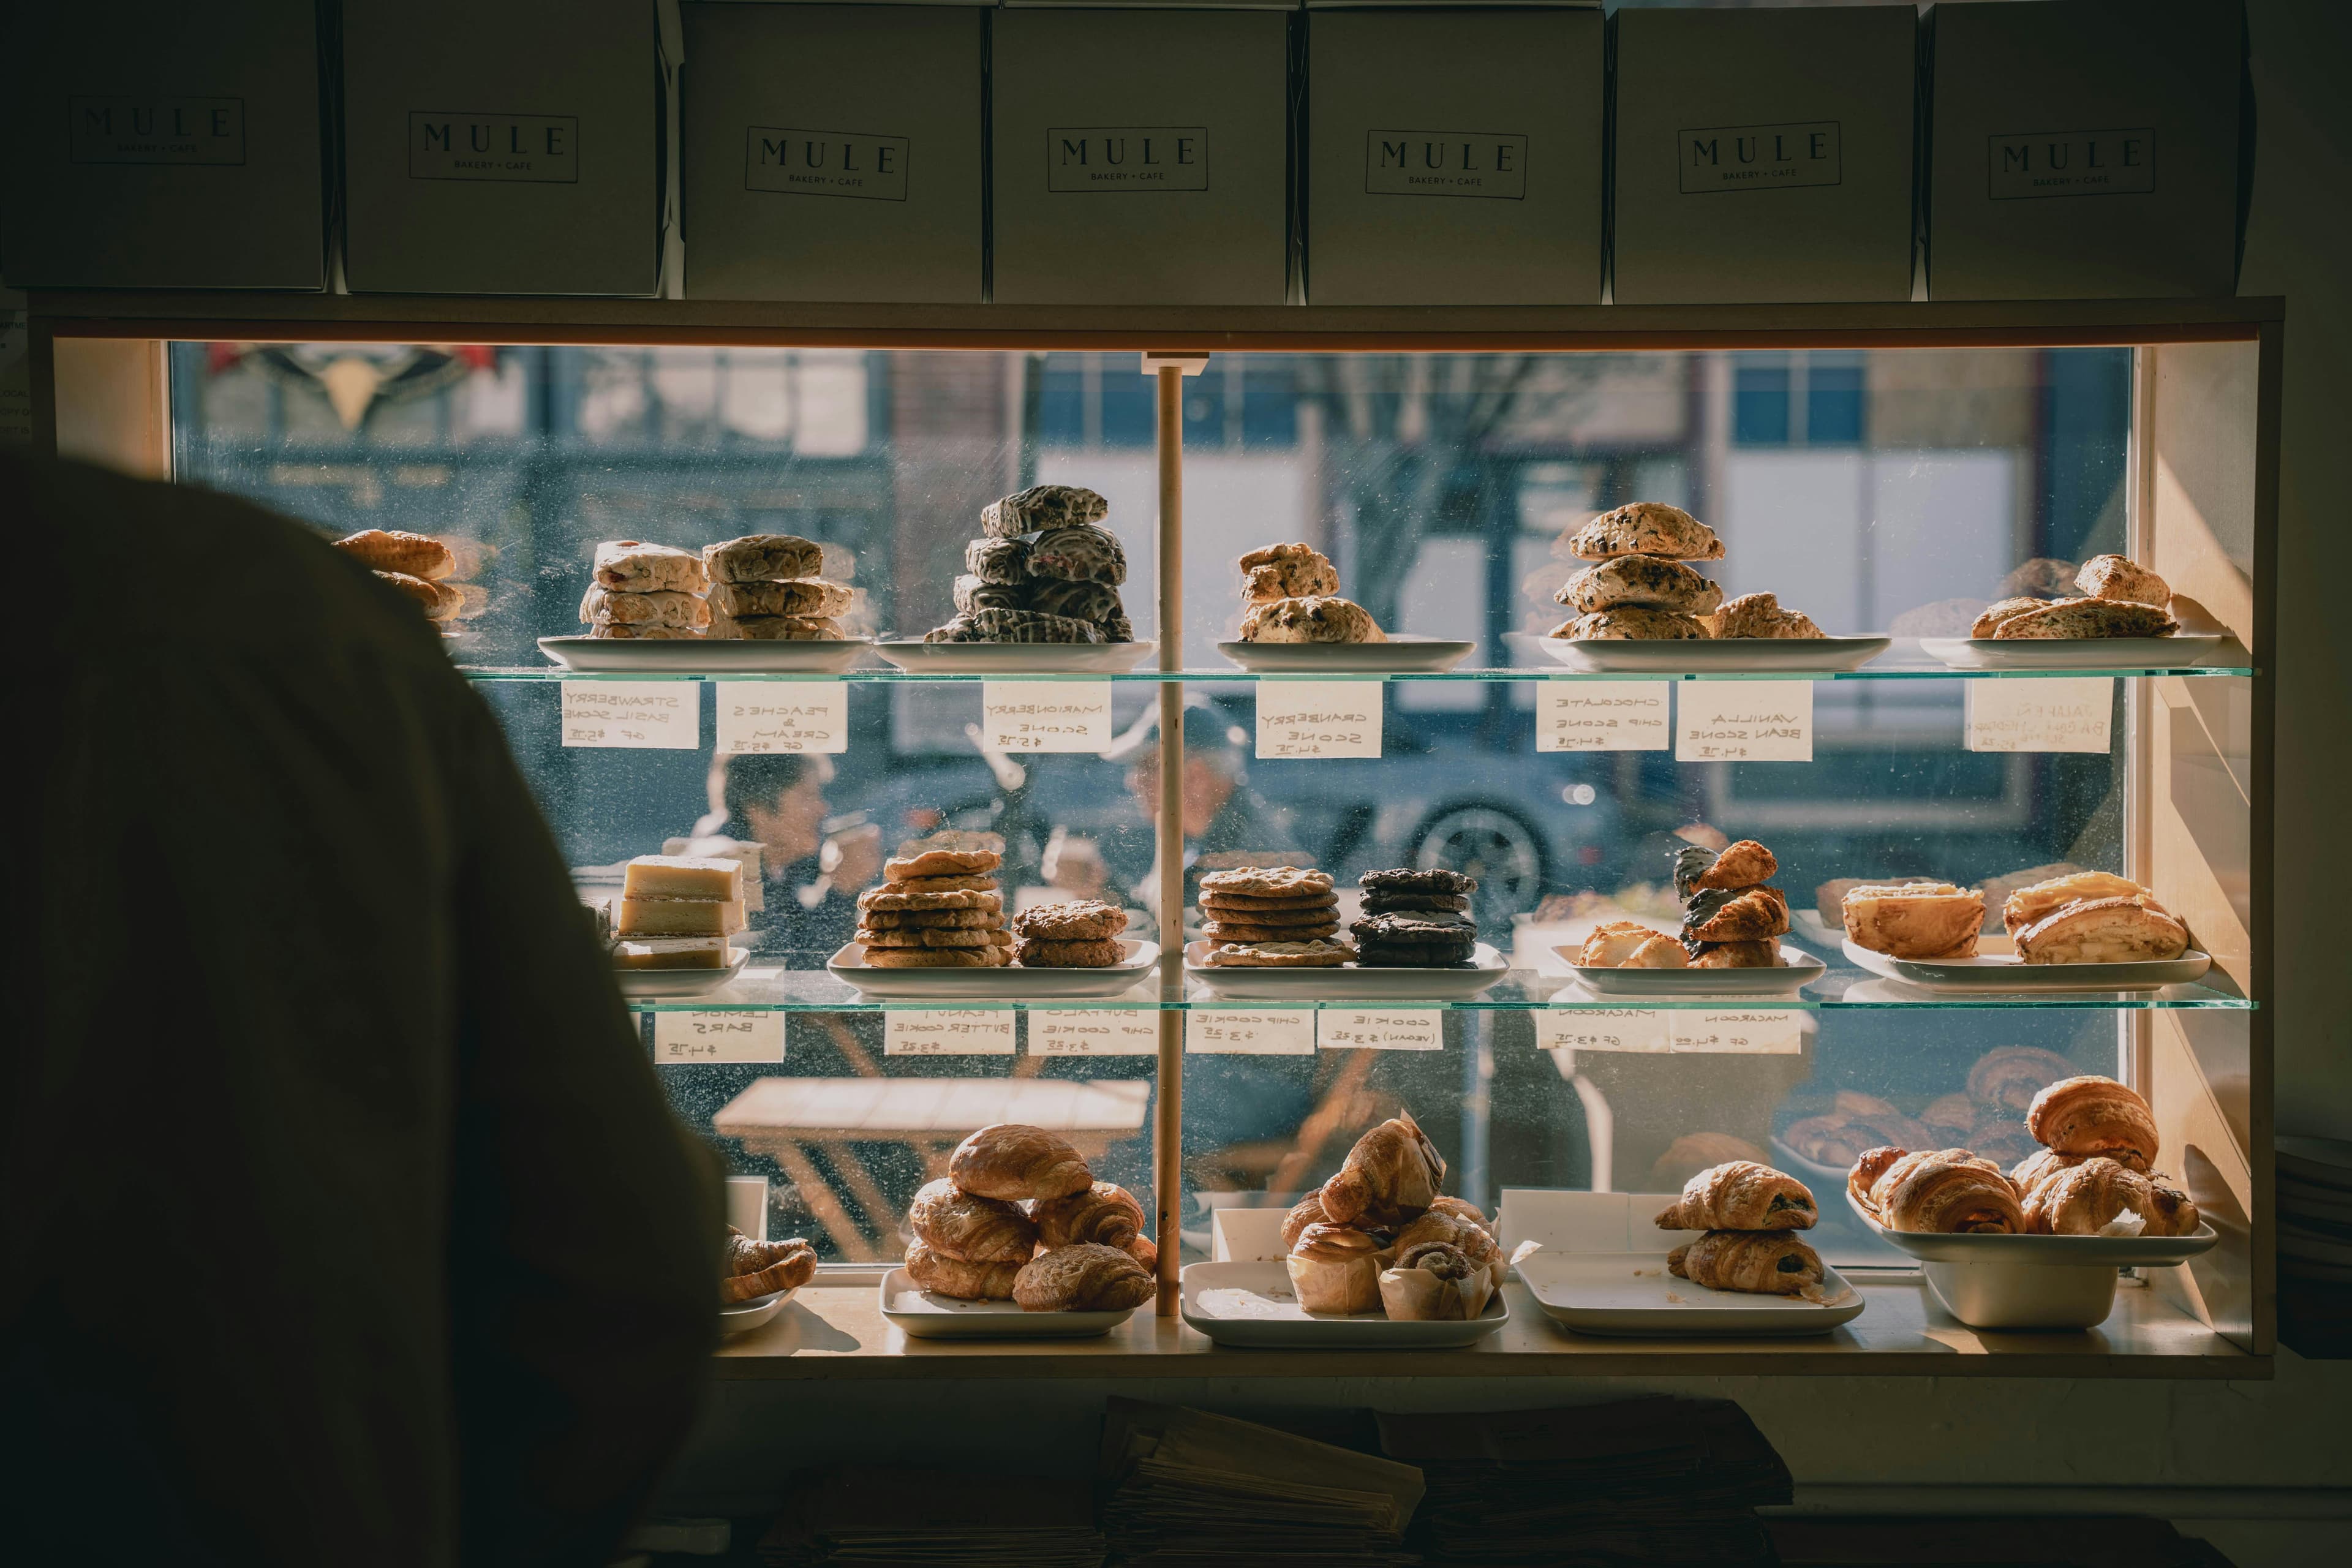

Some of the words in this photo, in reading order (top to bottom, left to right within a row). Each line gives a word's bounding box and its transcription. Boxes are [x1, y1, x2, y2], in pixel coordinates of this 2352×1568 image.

[85, 107, 230, 137] MULE
[423, 123, 564, 155] MULE
[1061, 138, 1194, 166] MULE
[1692, 132, 1827, 167] MULE
[454, 160, 494, 170] BAKERY
[505, 160, 533, 171] CAFE
[760, 138, 895, 174] MULE
[1380, 141, 1514, 172] MULE
[2003, 138, 2141, 173] MULE
[788, 175, 827, 184] BAKERY
[837, 178, 863, 187] CAFE
[1139, 172, 1164, 181] CAFE
[1408, 176, 1446, 185] BAKERY
[1457, 178, 1482, 186] CAFE
[1722, 170, 1760, 181] BAKERY
[1771, 168, 1797, 177] CAFE
[2033, 177, 2071, 187] BAKERY
[2083, 176, 2109, 184] CAFE
